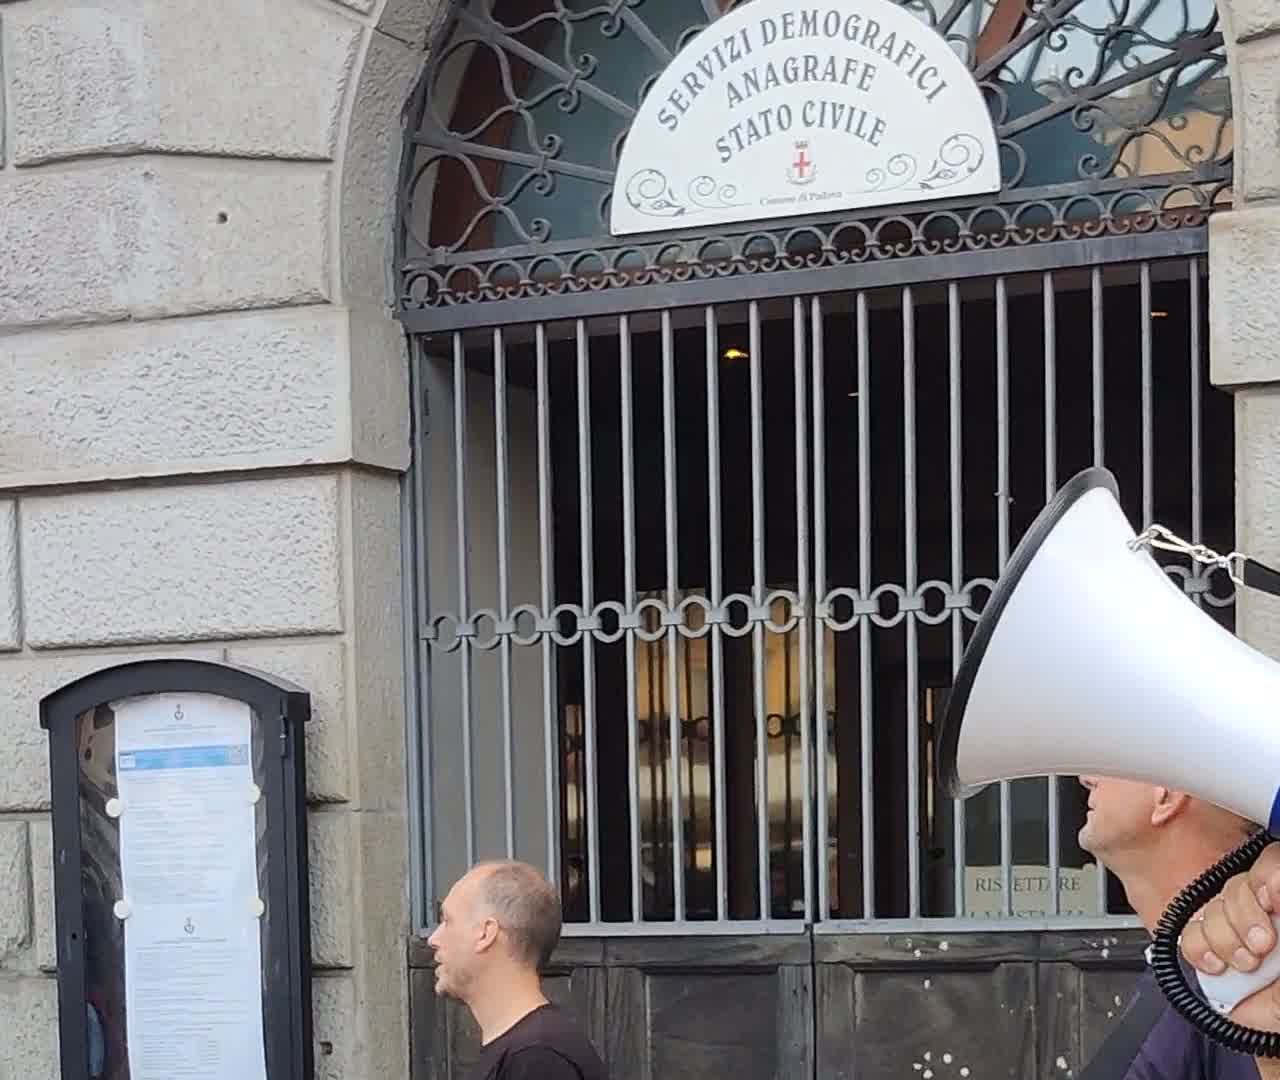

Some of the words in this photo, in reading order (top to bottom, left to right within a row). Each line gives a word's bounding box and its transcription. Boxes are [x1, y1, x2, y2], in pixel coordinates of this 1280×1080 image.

[658, 28, 752, 131] SERVIZI
[760, 9, 947, 103] DEMOGRAFICI
[726, 55, 877, 108] ANAGRAFE
[716, 104, 792, 163] STATO
[802, 100, 887, 147] CIVILE
